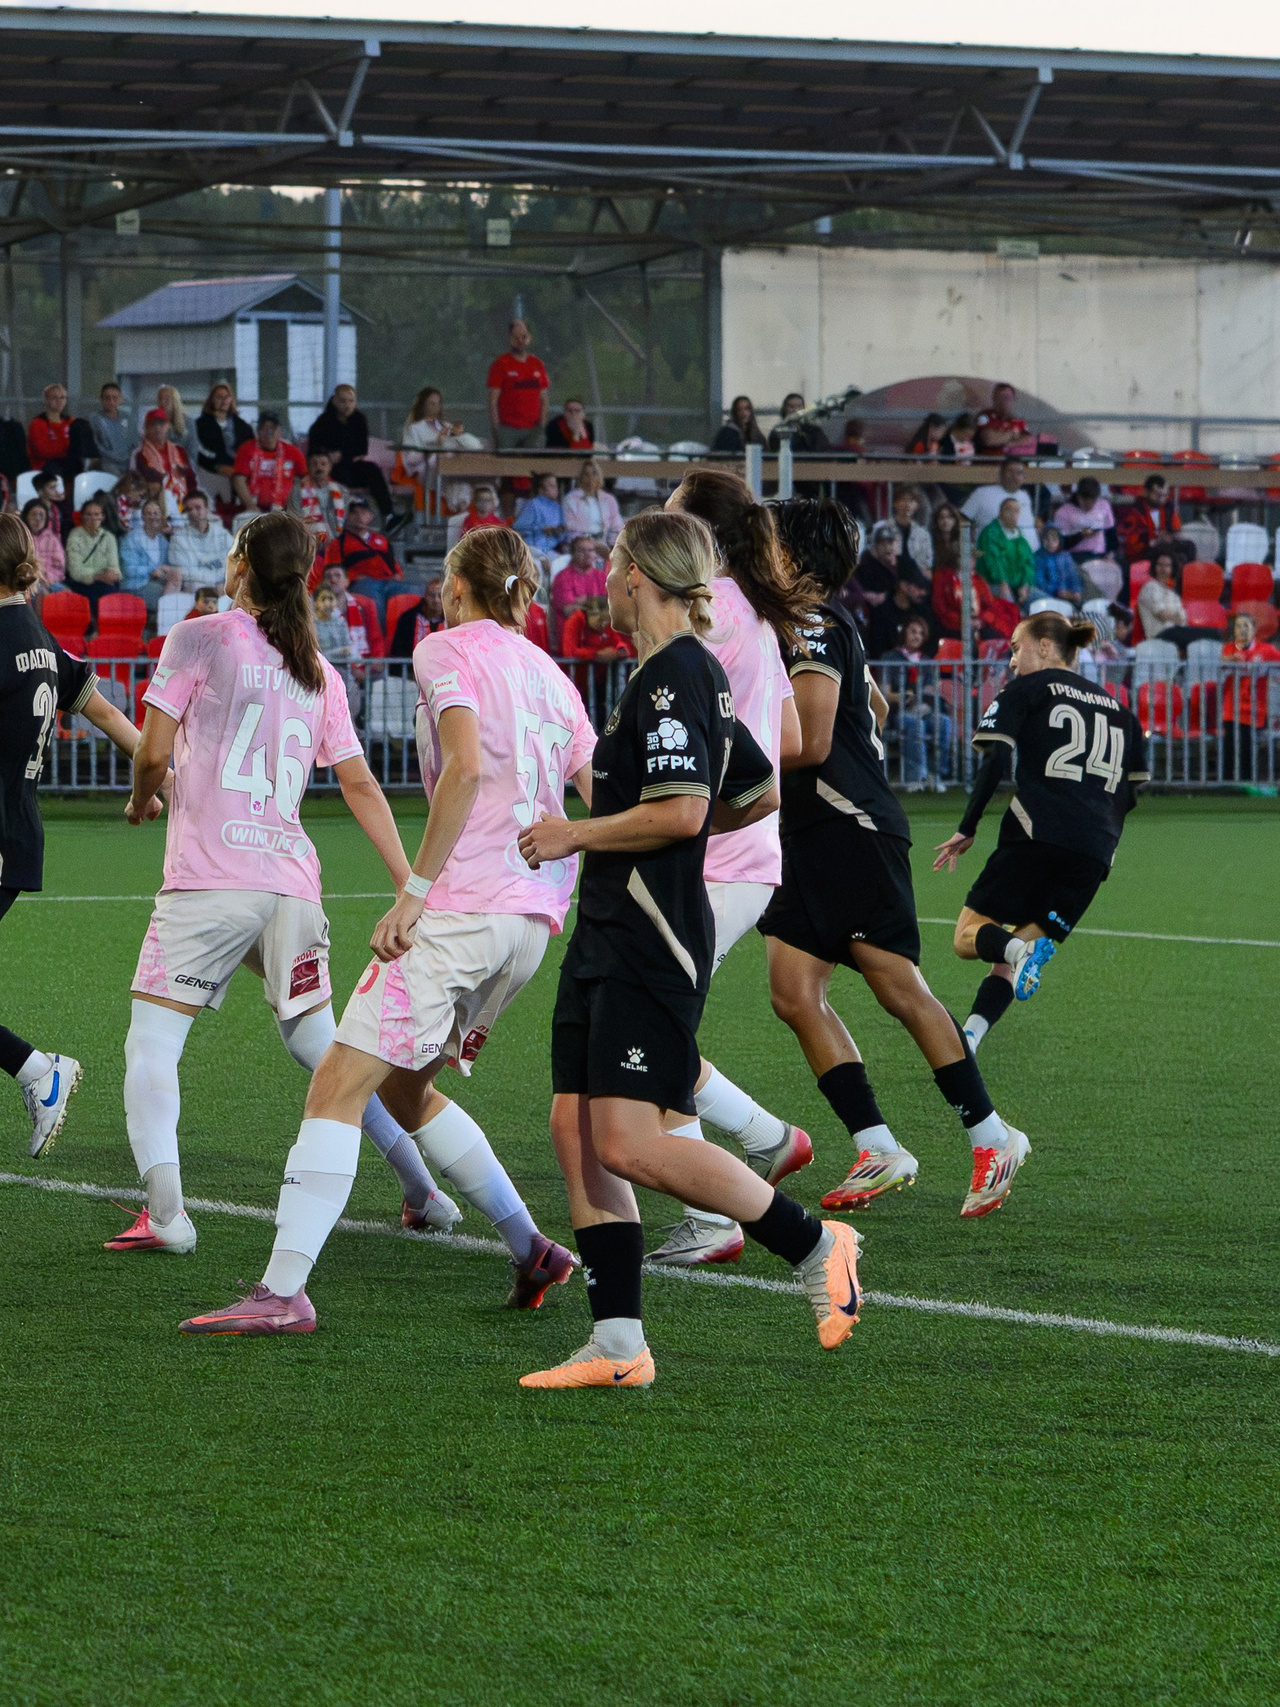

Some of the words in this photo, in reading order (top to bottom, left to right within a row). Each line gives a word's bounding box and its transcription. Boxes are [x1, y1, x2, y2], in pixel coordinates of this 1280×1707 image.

[1047, 683, 1120, 711] ТРЕНЬКИНА
[646, 736, 659, 744] 30
[1044, 704, 1124, 794] 24
[221, 702, 312, 825] 46
[646, 755, 697, 774] FFPK
[620, 1061, 648, 1073] KELME
